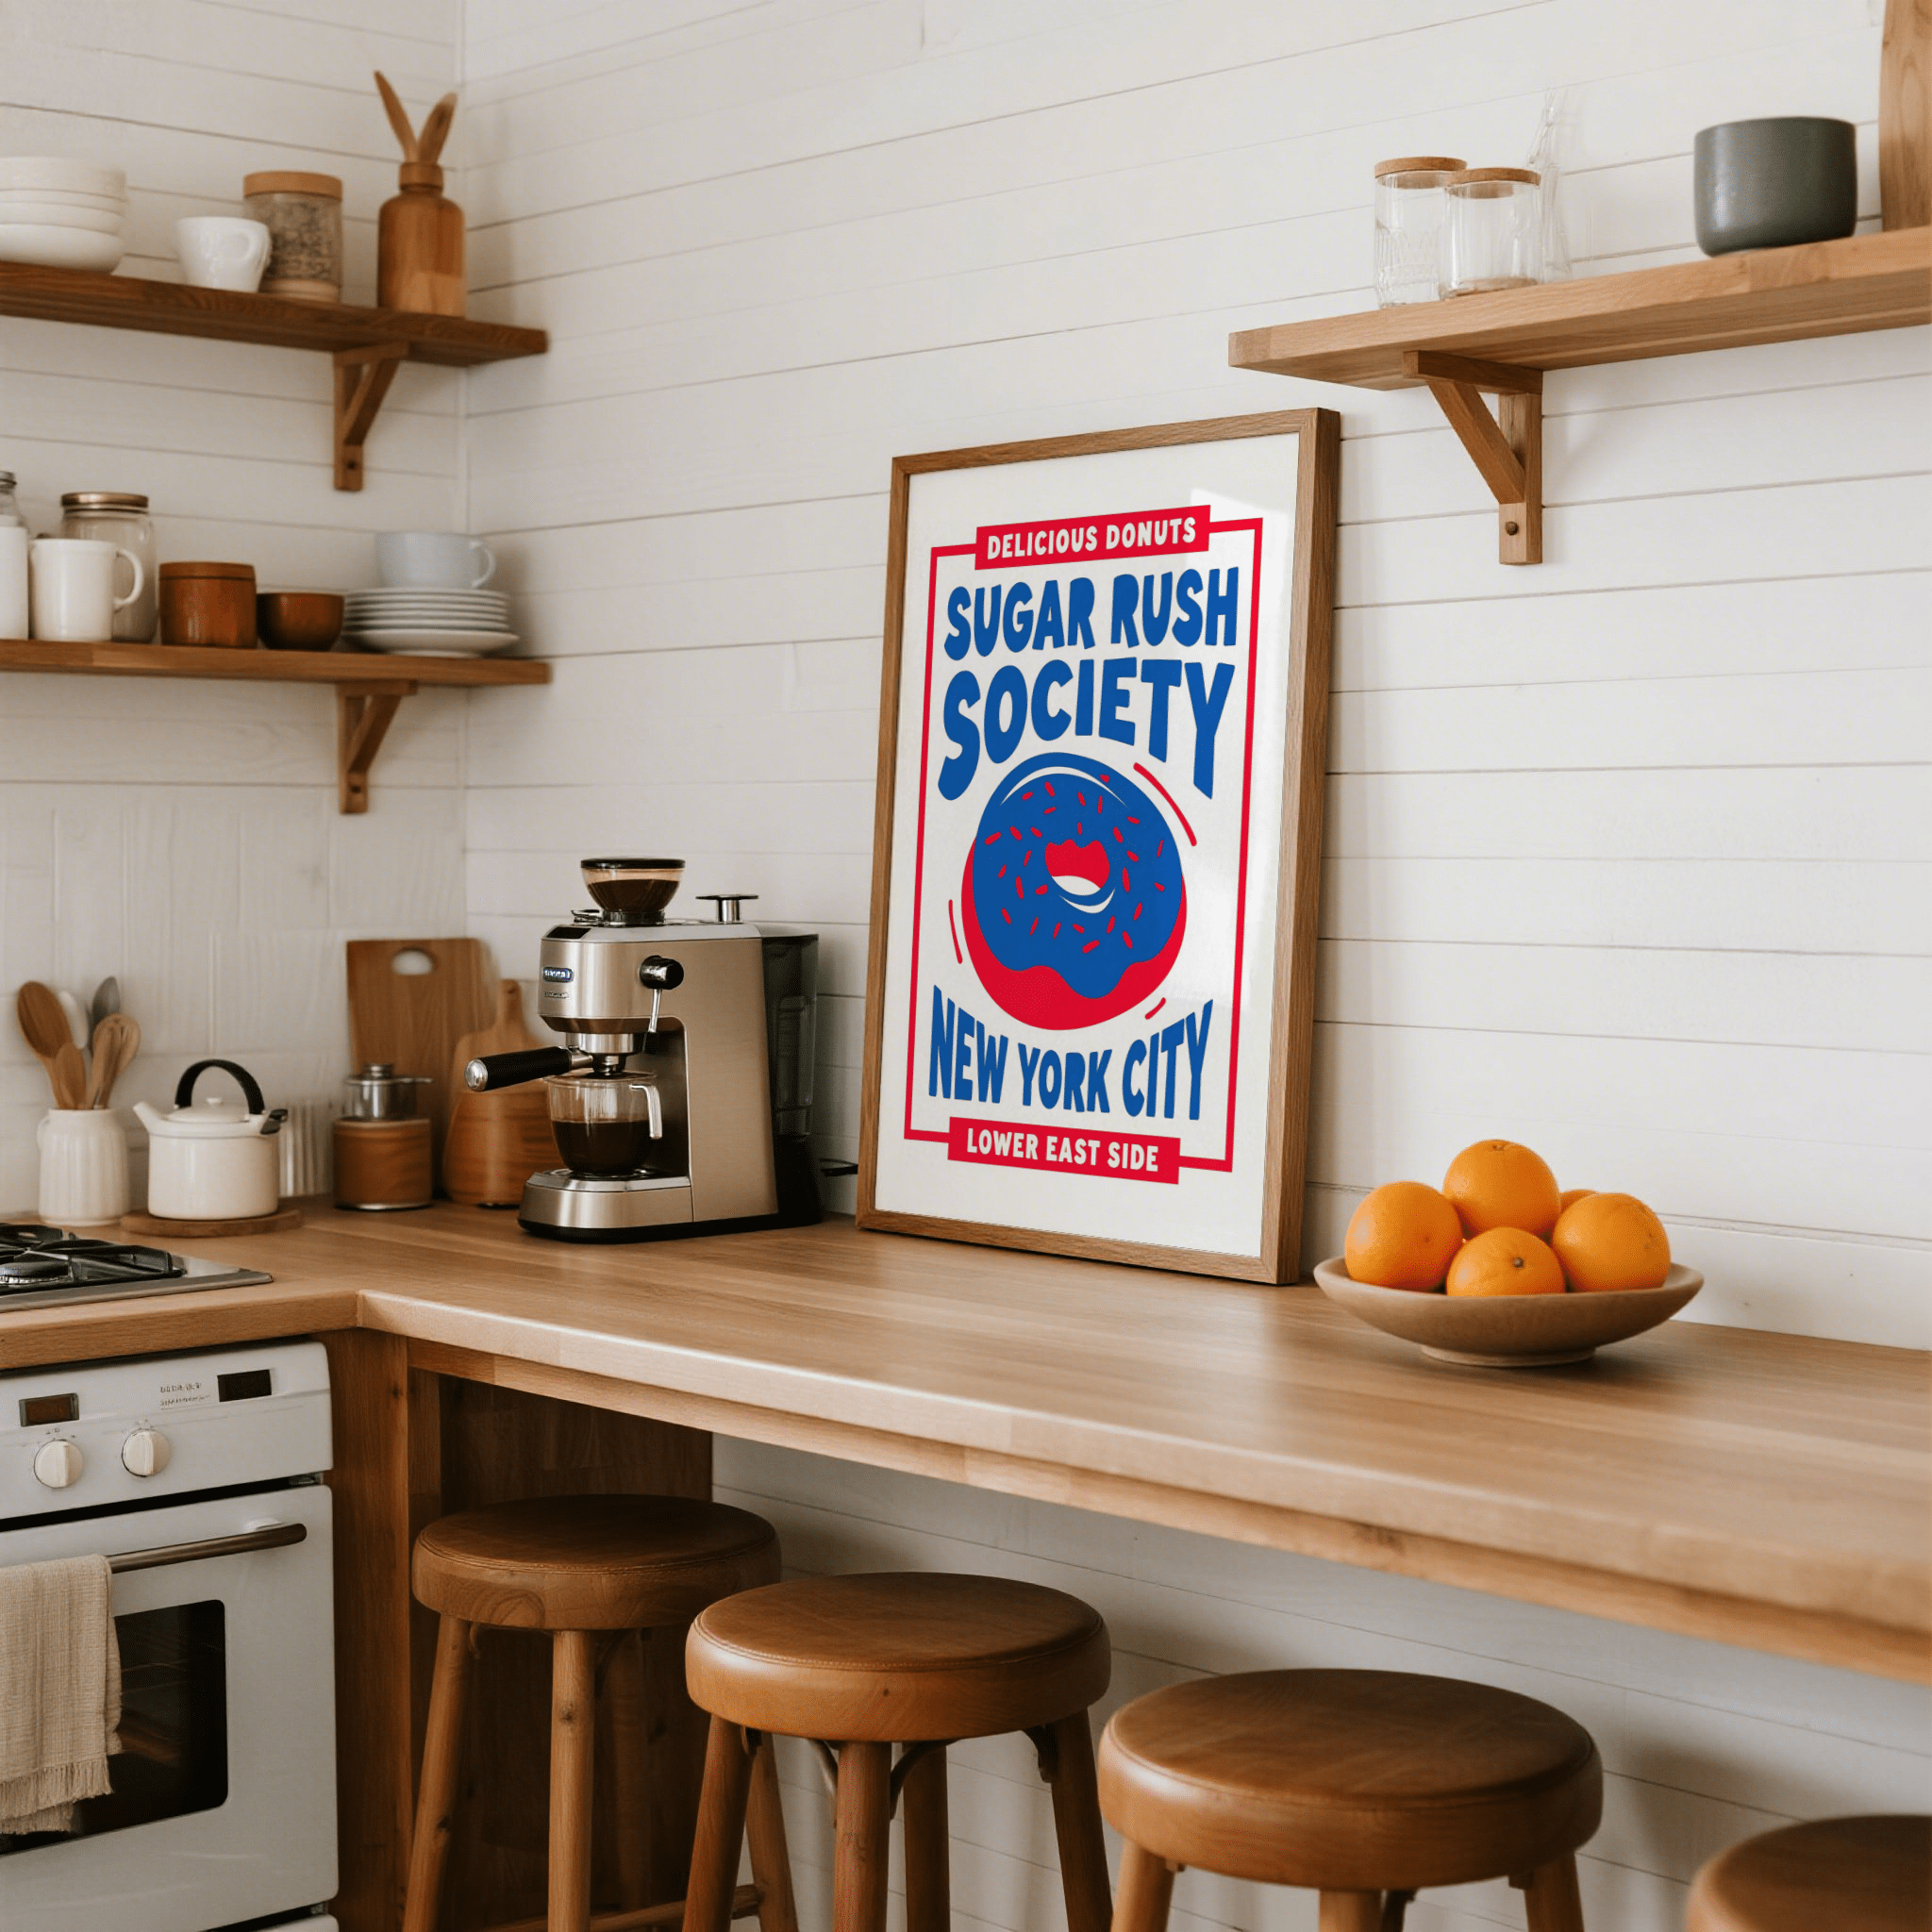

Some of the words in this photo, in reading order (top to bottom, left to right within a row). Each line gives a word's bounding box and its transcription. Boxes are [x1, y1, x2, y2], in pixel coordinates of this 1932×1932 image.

[988, 525, 1098, 559] DELICIOUS
[1106, 517, 1196, 550] DONUTS
[944, 577, 1096, 661] SUGAR
[1111, 567, 1239, 649] RUSH
[938, 658, 1236, 801] SOCIETY
[929, 985, 1009, 1104] NEW
[1018, 1043, 1113, 1113] YORK
[1123, 1000, 1214, 1121] CITY
[968, 1128, 1039, 1160] LOWER
[1046, 1136, 1101, 1166] EAST
[1108, 1142, 1158, 1173] SIDE
